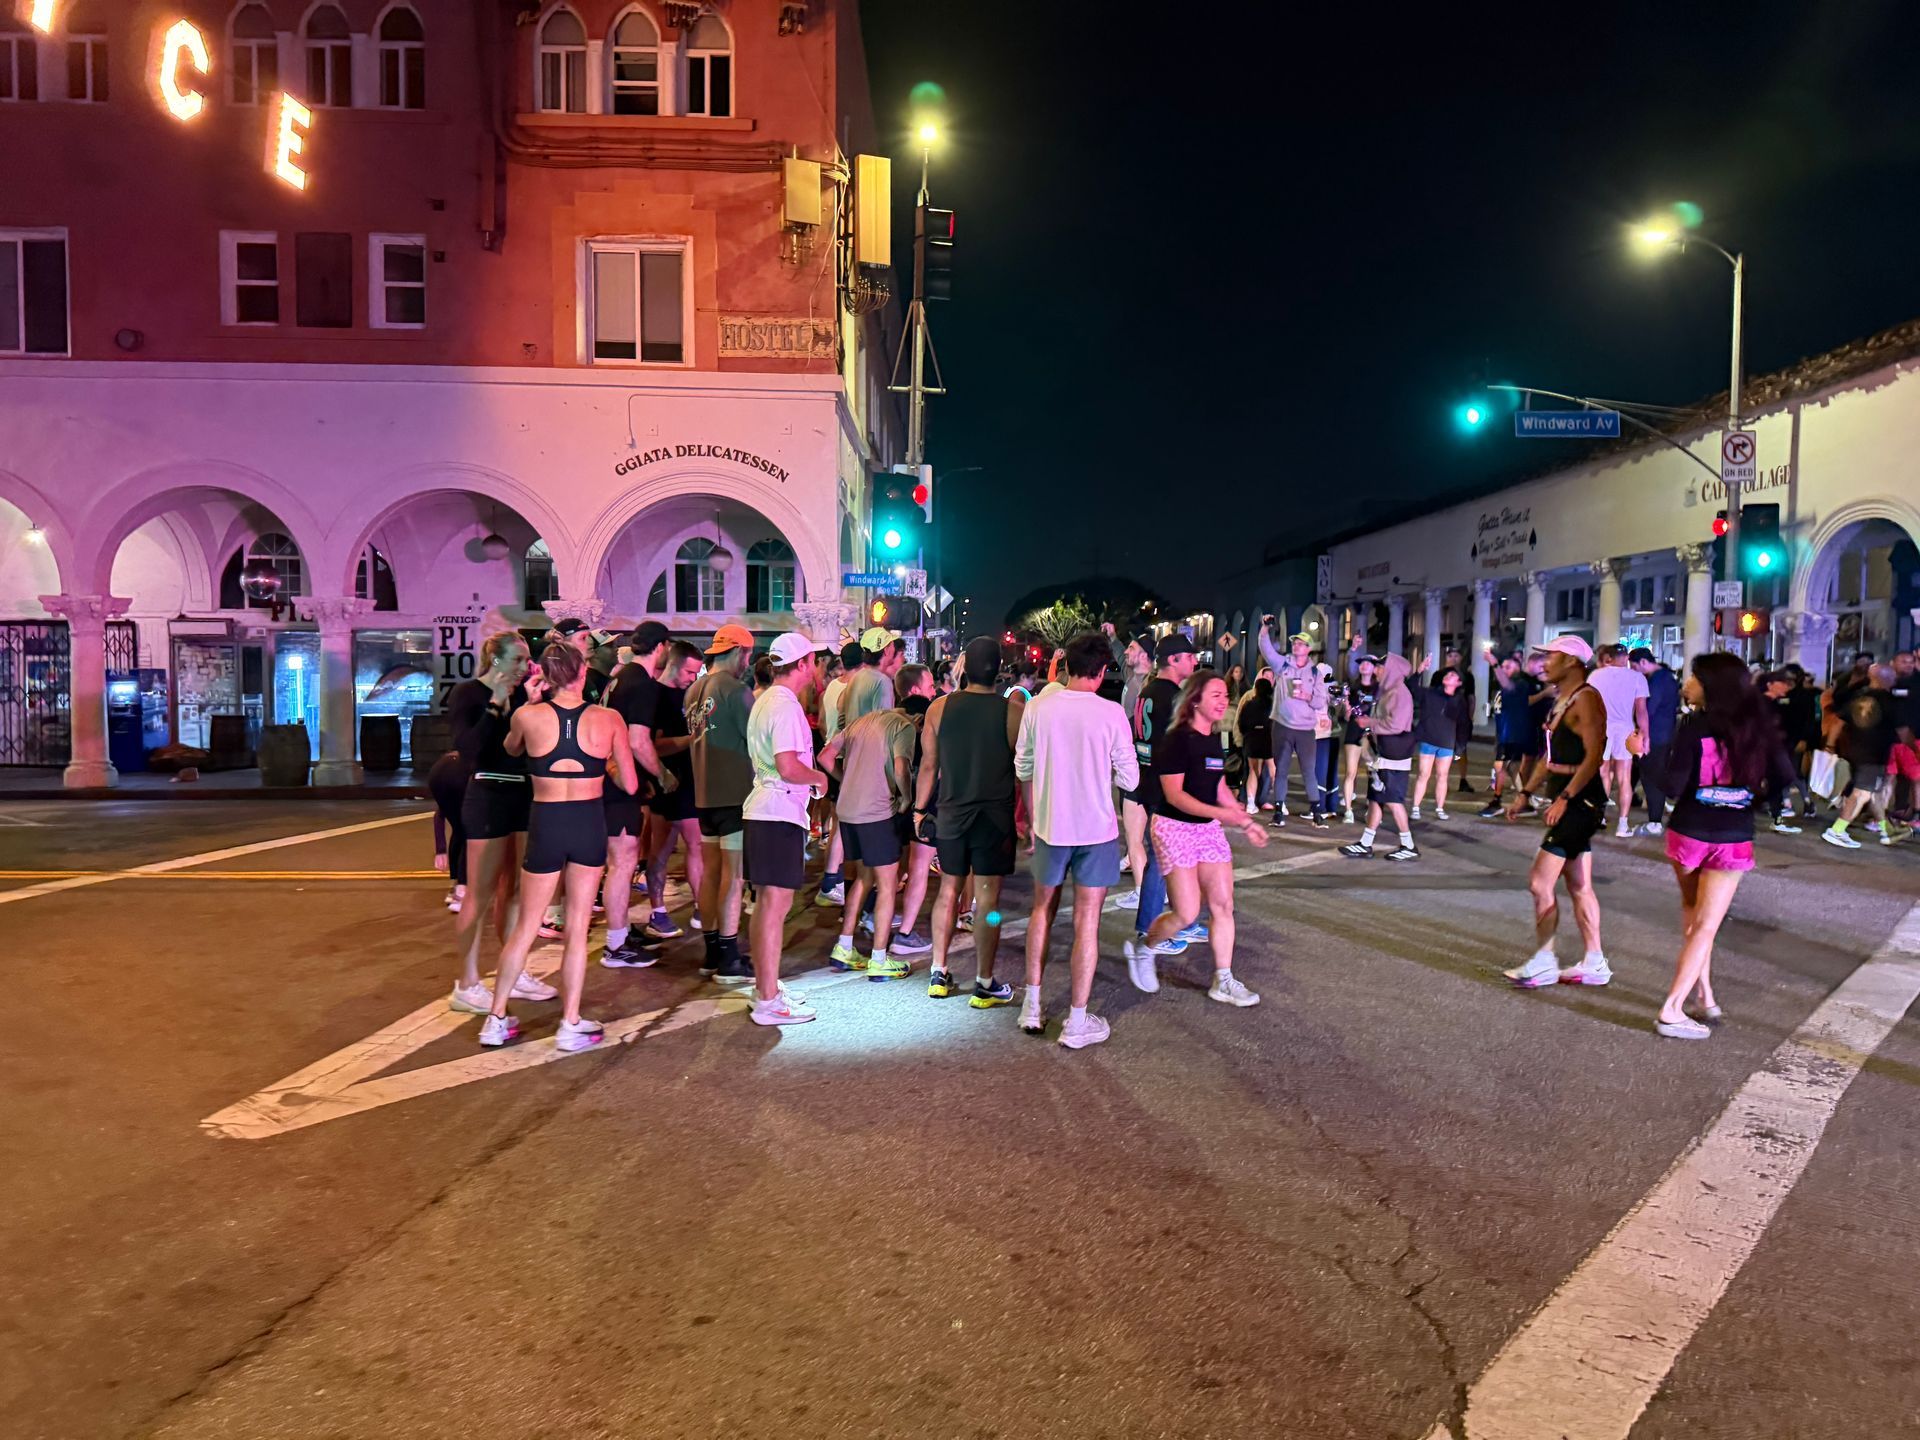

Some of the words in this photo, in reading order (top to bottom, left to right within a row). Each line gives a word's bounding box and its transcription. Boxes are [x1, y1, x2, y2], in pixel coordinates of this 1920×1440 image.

[720, 324, 811, 351] HOSTEL
[1522, 416, 1591, 430] Windward
[1596, 417, 1613, 430] Av
[615, 447, 672, 476] GGIATA
[675, 444, 790, 483] DELICATESSEN
[1725, 468, 1736, 478] ON
[1738, 467, 1754, 478] RED
[1740, 465, 1792, 495] OLLAGE
[849, 575, 887, 585] Windward
[1715, 594, 1727, 605] OK
[437, 615, 478, 624] VENICE
[439, 626, 474, 651] PL
